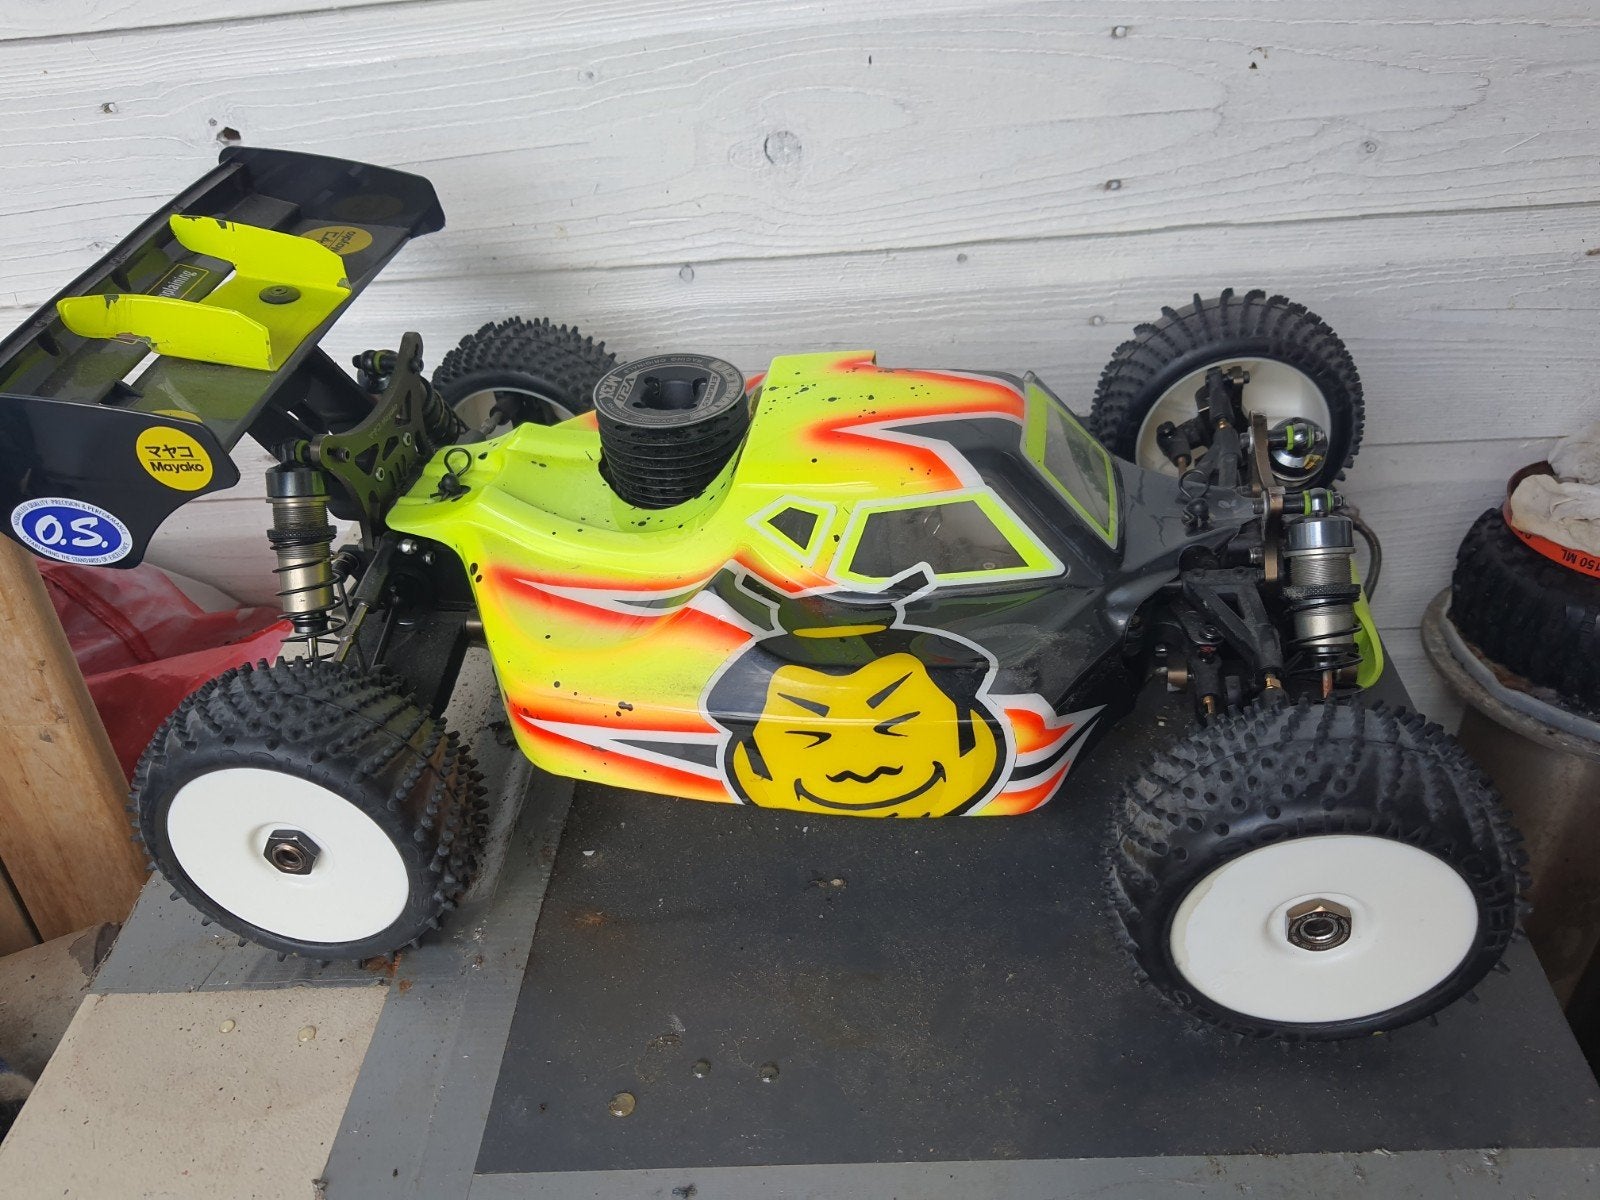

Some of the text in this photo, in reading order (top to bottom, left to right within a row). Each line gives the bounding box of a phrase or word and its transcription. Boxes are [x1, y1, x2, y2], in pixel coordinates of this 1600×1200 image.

[598, 374, 623, 400] M3X
[145, 444, 194, 459] マヤコ
[150, 461, 205, 474] Mayako
[34, 514, 109, 549] O.S.
[1561, 549, 1578, 564] ML
